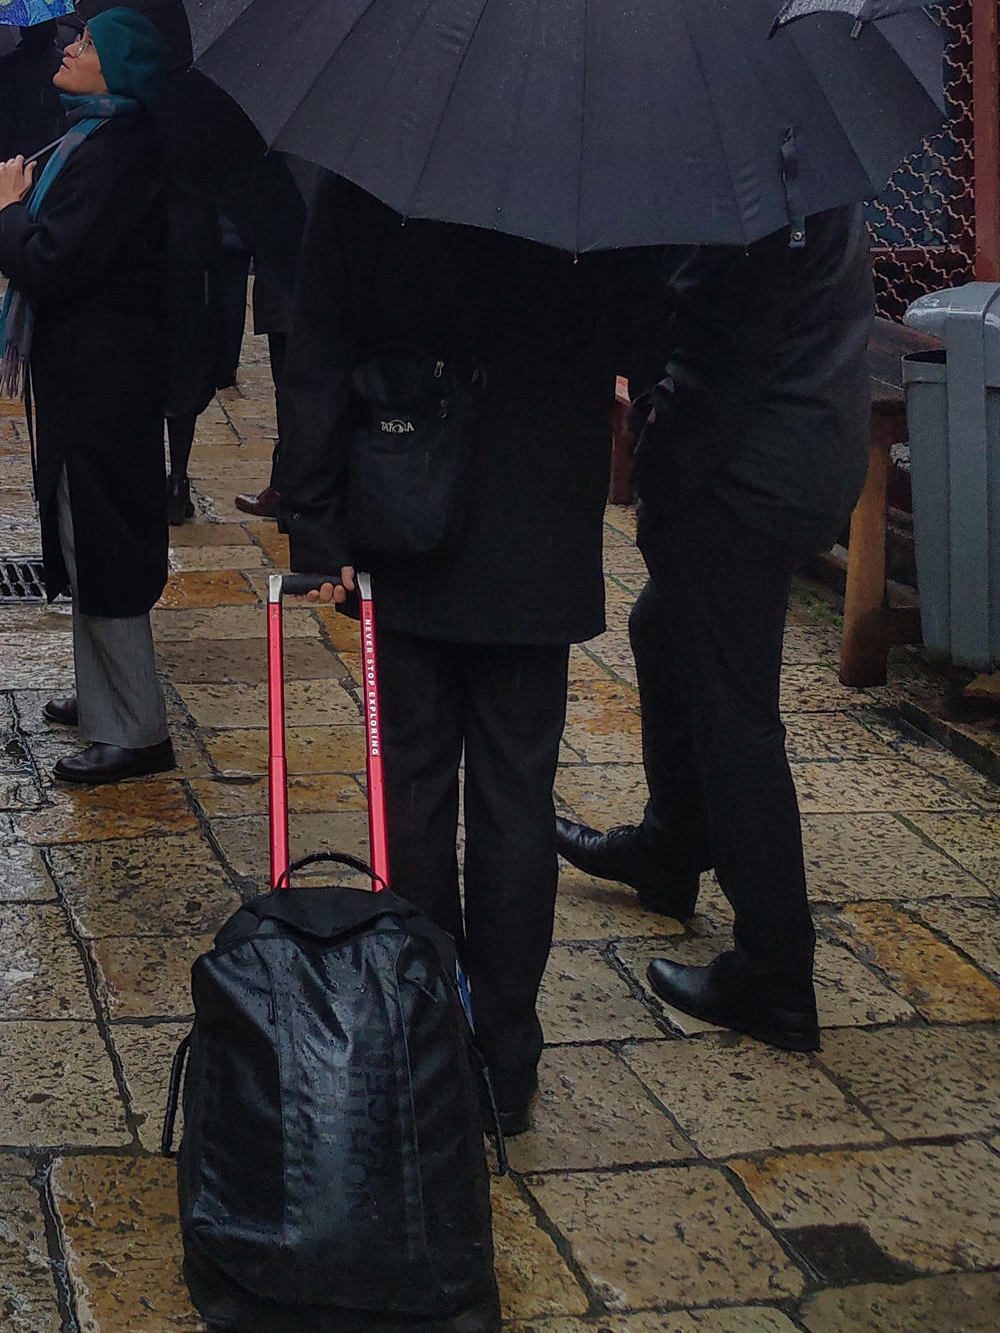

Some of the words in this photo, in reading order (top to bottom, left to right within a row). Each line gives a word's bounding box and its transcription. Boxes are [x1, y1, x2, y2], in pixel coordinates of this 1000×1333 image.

[364, 619, 373, 653] NEVER
[366, 658, 375, 686] STOP
[368, 691, 379, 756] EXPLORING
